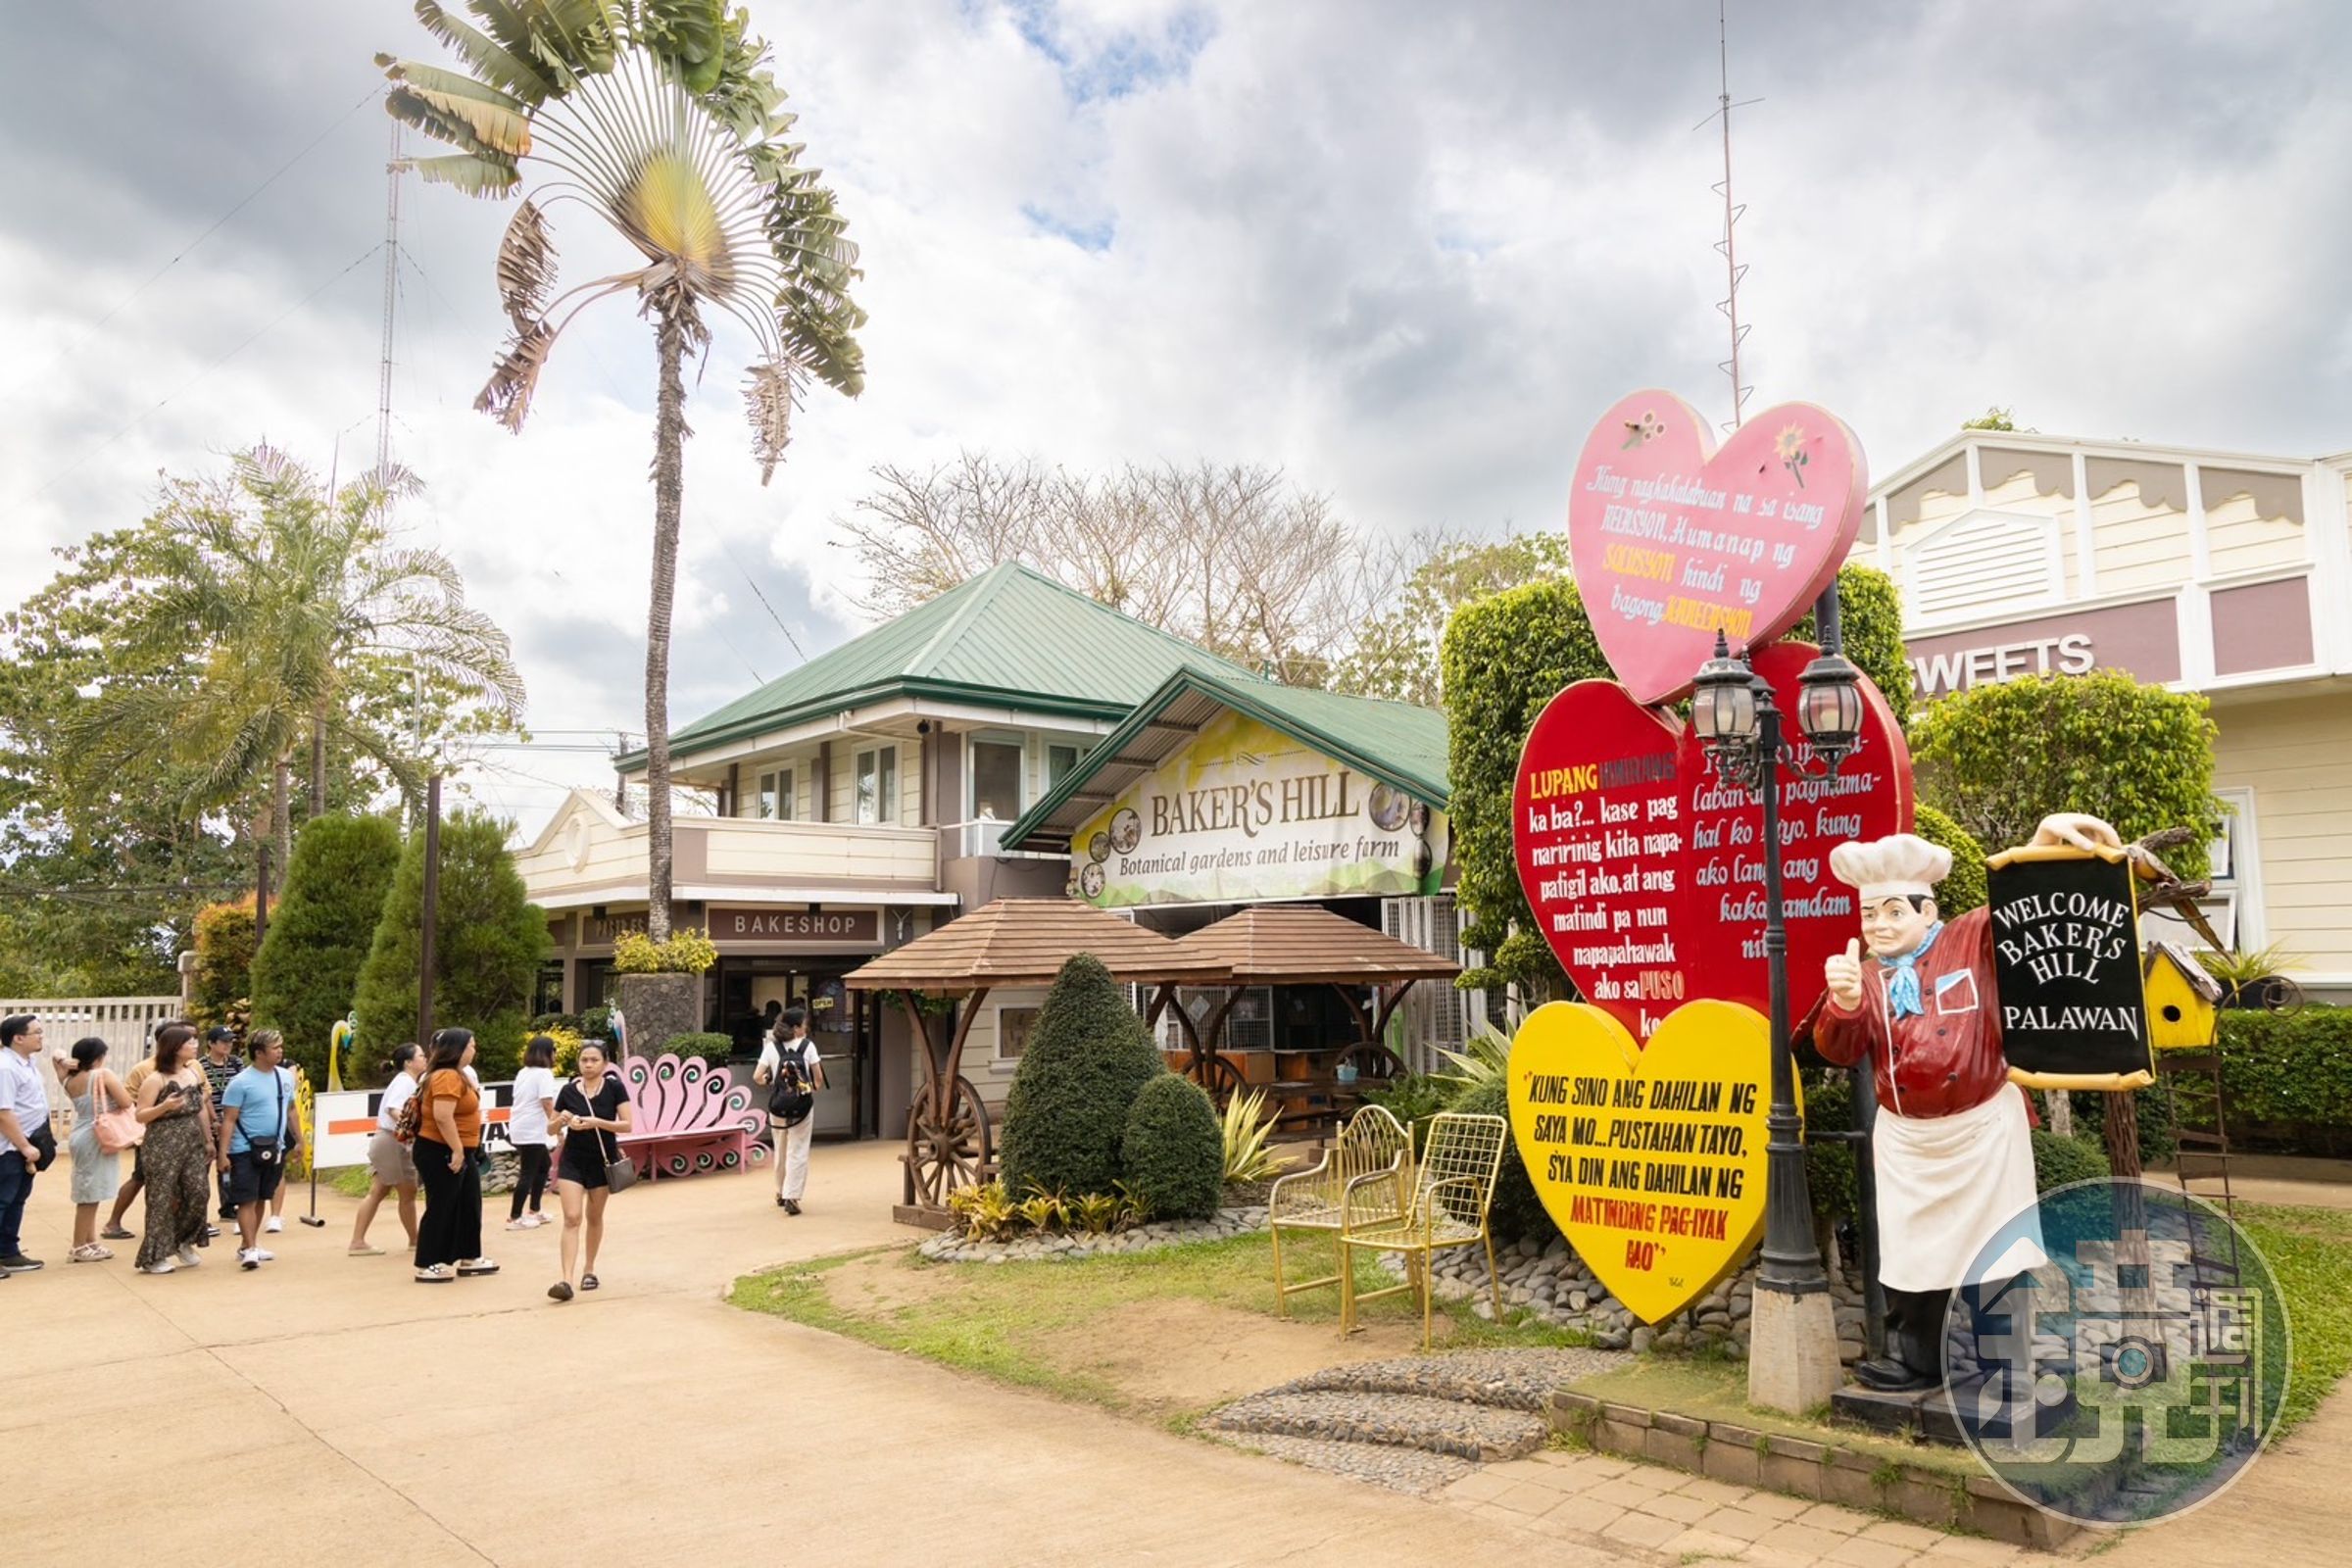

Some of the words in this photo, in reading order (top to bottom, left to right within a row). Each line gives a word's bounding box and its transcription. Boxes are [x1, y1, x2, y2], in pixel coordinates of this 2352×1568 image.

[1733, 494, 1753, 514] na
[1757, 497, 1778, 516] sa
[1783, 491, 1824, 529] isang
[1669, 515, 1764, 564] Humanap
[1772, 542, 1796, 569] ng
[1681, 557, 1728, 593] hindi
[1740, 577, 1763, 605] ng
[1611, 584, 1664, 625] bagong
[1530, 763, 1597, 800] LUPANG
[1692, 783, 1744, 811] laban
[1151, 779, 1273, 838] BAKER'S
[1280, 771, 1359, 823] HILL
[1529, 807, 1547, 833] ka
[1599, 796, 1639, 824] kase
[1647, 795, 1679, 822] pag
[1692, 818, 1727, 850] hal
[1730, 816, 1753, 845] ko
[1816, 807, 1862, 838] kung
[1119, 850, 1186, 876] Botanical
[1190, 848, 1251, 874] gardens
[1256, 843, 1288, 864] and
[1293, 838, 1349, 862] leisure
[1355, 836, 1399, 862] farm
[1532, 833, 1601, 866] naririnig
[1605, 829, 1640, 858] kita
[1540, 868, 1587, 902] patigil
[1642, 869, 1676, 892] ang
[1696, 857, 1728, 886] ako
[1783, 857, 1819, 884] ang
[1553, 902, 1607, 932] matindi
[1613, 909, 1631, 933] pa
[1637, 906, 1668, 927] nun
[1719, 886, 1850, 922] kakaamdam
[1992, 892, 2130, 929] WELCOME
[735, 915, 856, 934] BAKESHOP
[1573, 932, 1676, 969] napapahawak
[1996, 922, 2127, 966] BAKER'S
[1593, 971, 1620, 1000] ako
[1624, 980, 1640, 999] sa
[1640, 970, 1685, 1000] PUSO
[2028, 953, 2100, 986] HILL
[2003, 1005, 2139, 1041] PALAWAN
[1571, 1077, 1608, 1107] SINO
[1612, 1079, 1645, 1109] ANG
[1649, 1081, 1723, 1113] DAHILAN
[1729, 1083, 1757, 1114] NG
[1534, 1114, 1567, 1145] SAYA
[1699, 1124, 1748, 1158] TAYO,
[1578, 1157, 1604, 1187] DIN
[1608, 1160, 1641, 1191] ANG
[1644, 1163, 1714, 1197] DAHILAN
[1715, 1169, 1744, 1200] NG
[1570, 1195, 1656, 1233] MATINDING
[1659, 1204, 1729, 1241] PAG-IYAK
